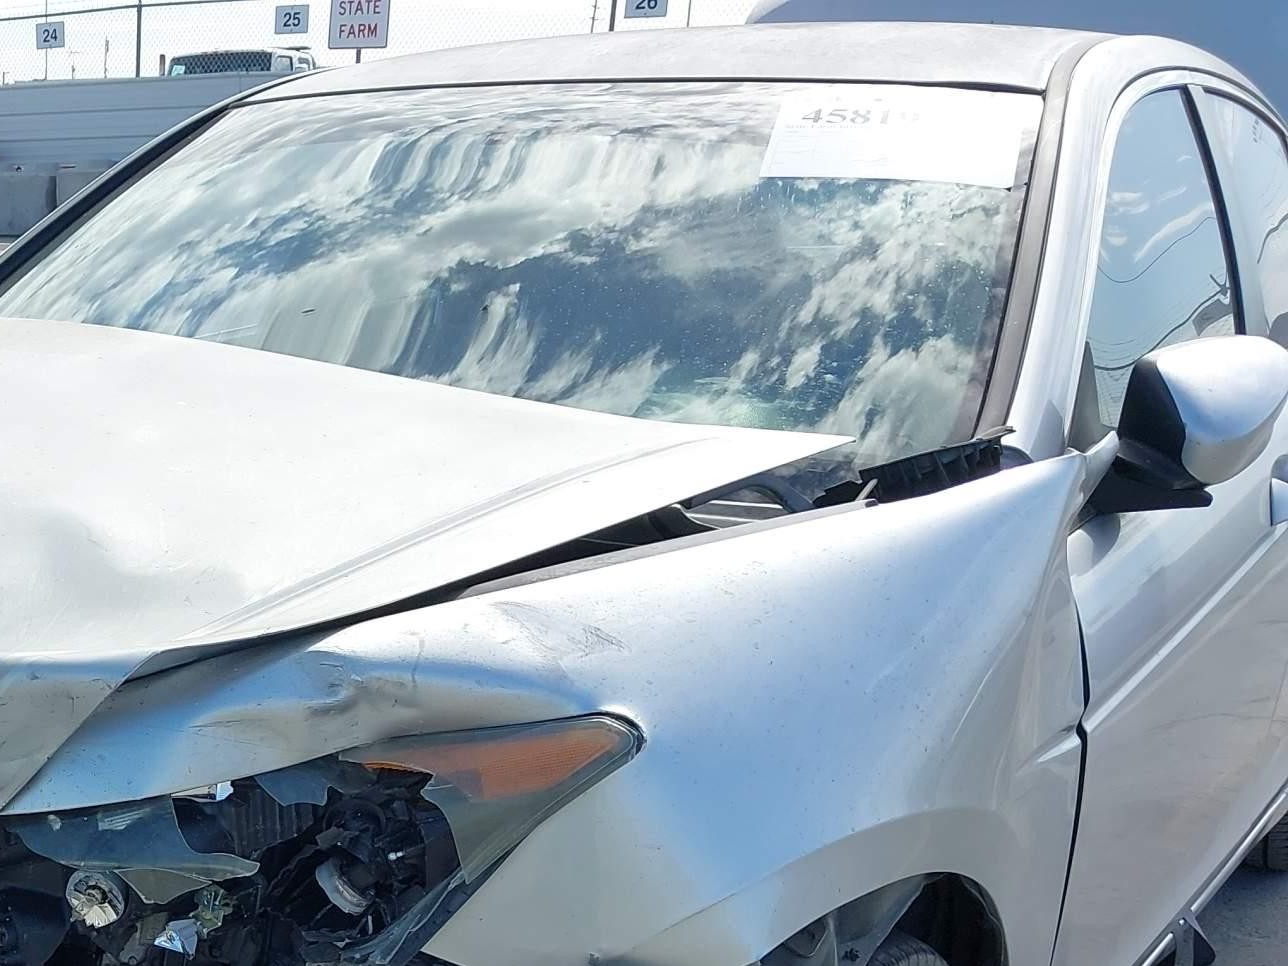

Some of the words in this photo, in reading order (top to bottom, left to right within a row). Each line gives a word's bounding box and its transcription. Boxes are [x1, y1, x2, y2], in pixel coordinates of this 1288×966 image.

[338, 0, 382, 16] STATE
[283, 11, 301, 28] 25
[42, 28, 58, 43] 24
[338, 23, 378, 39] FARM
